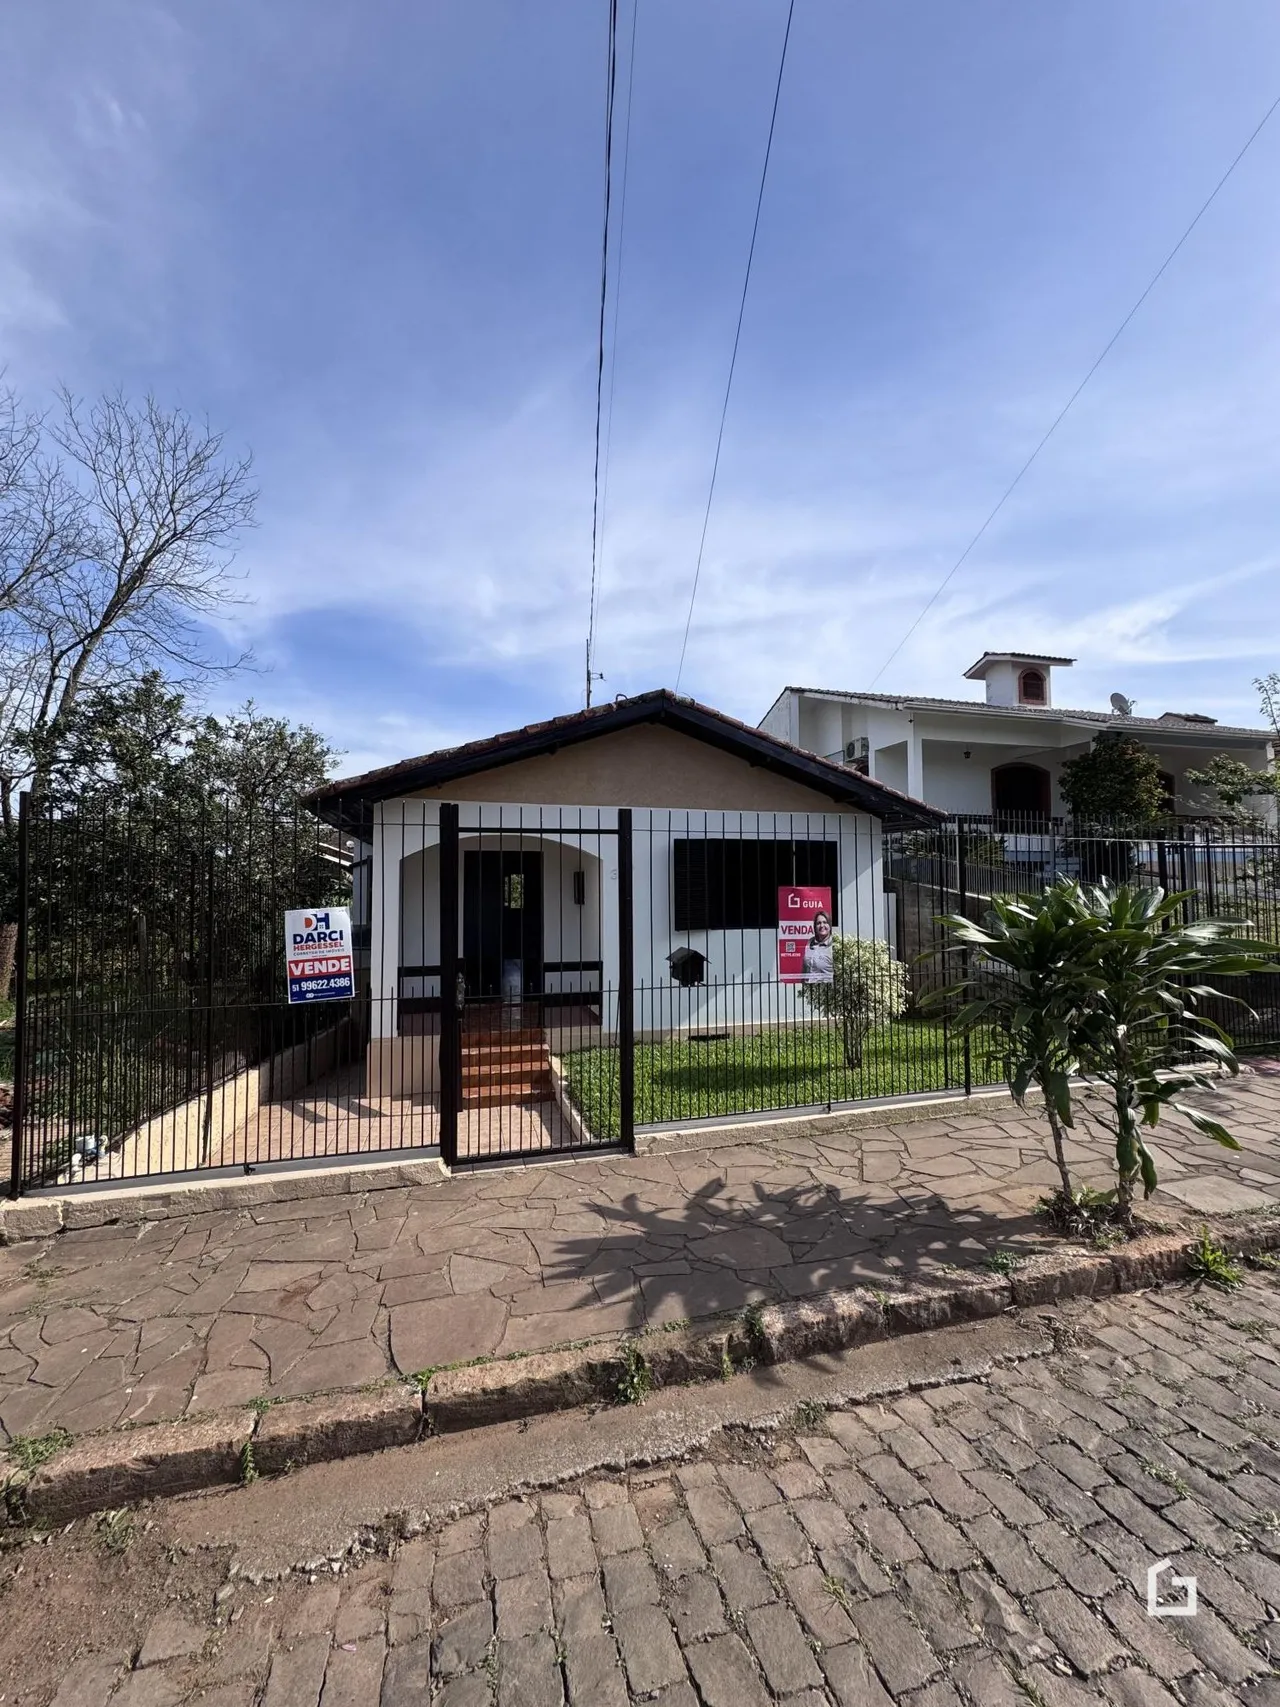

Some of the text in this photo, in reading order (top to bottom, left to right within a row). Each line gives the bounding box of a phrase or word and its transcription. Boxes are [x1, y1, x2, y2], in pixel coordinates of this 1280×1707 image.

[802, 900, 823, 908] GUIA
[304, 913, 330, 931] DH
[293, 930, 344, 945] DARCI
[781, 925, 814, 935] VENDA
[293, 942, 344, 951] HERGESSEL
[290, 958, 350, 976] VENDE
[292, 977, 350, 992] 51 99622.4386
